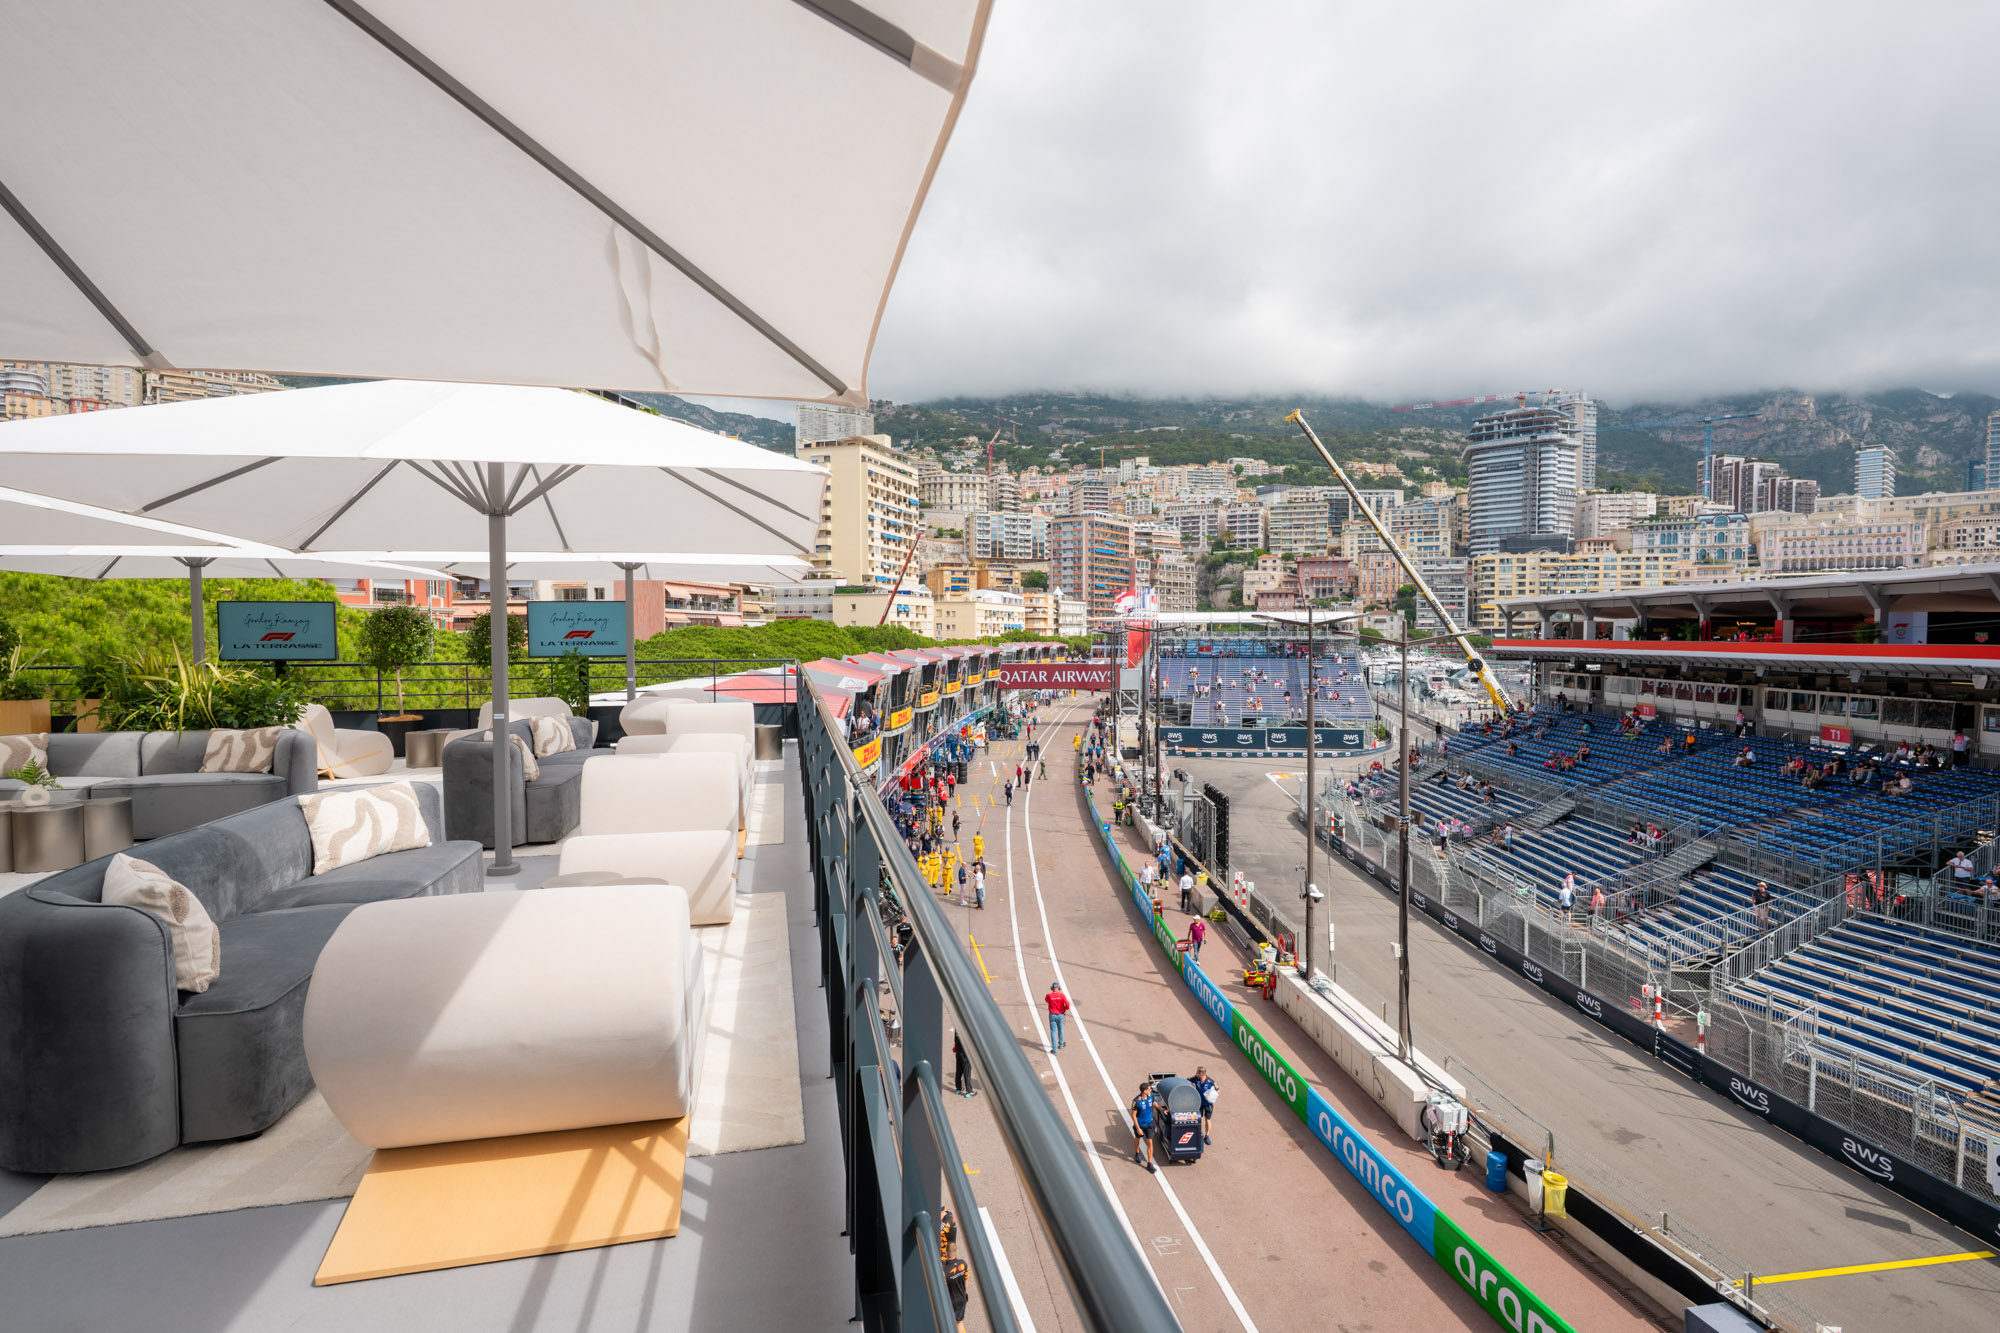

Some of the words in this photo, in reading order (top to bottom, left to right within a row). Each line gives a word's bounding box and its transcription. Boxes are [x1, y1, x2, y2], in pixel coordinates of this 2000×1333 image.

[274, 612, 313, 634] Ramsay
[576, 611, 610, 632] Ramsay
[999, 671, 1048, 685] QATAR
[1642, 706, 1650, 714] T1
[1202, 732, 1217, 740] aws
[1830, 729, 1840, 740] T1
[1414, 892, 1426, 905] aws
[1444, 912, 1458, 925] aws
[1156, 921, 1180, 967] aramco
[1480, 934, 1496, 949] aws
[1523, 960, 1543, 977] aws
[1187, 967, 1225, 1023] aramco
[1577, 992, 1601, 1012] aws
[1239, 1025, 1296, 1103] aramco
[1731, 1077, 1769, 1106] aws
[1843, 1137, 1893, 1172] aws
[1318, 1111, 1414, 1224] aramco
